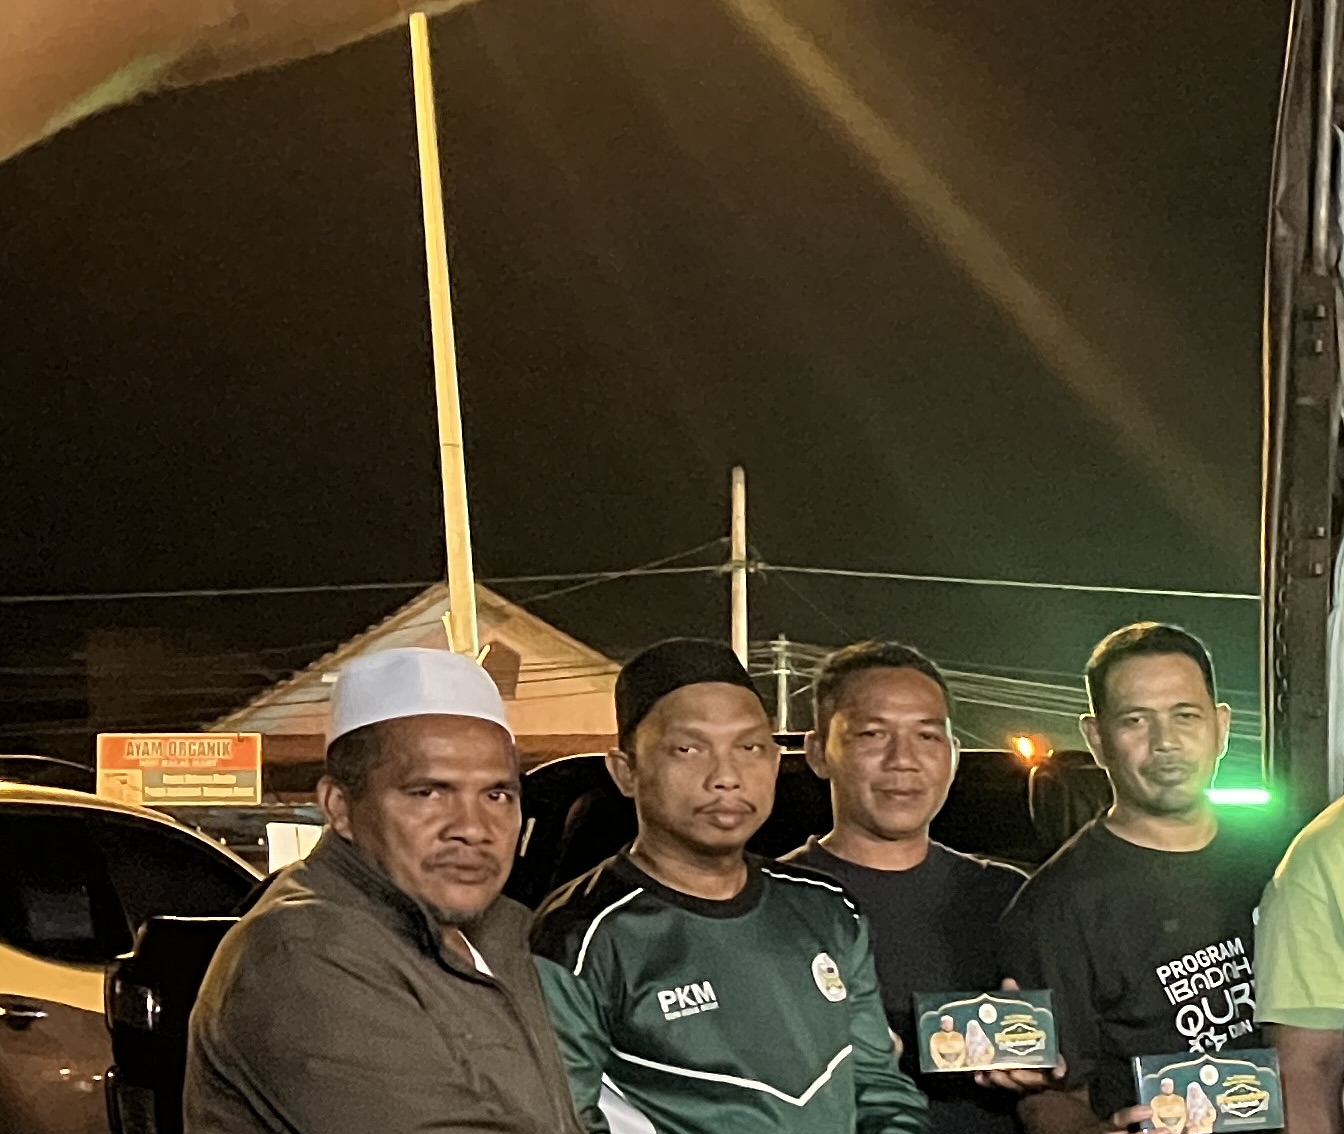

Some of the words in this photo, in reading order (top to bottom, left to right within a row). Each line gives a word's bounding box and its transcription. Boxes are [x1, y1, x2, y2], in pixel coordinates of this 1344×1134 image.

[125, 740, 163, 757] AYAM
[167, 740, 232, 757] ORGANIK
[1156, 937, 1245, 985] PROGRAM
[657, 980, 717, 1013] PKM
[1175, 981, 1256, 1038] QUR
